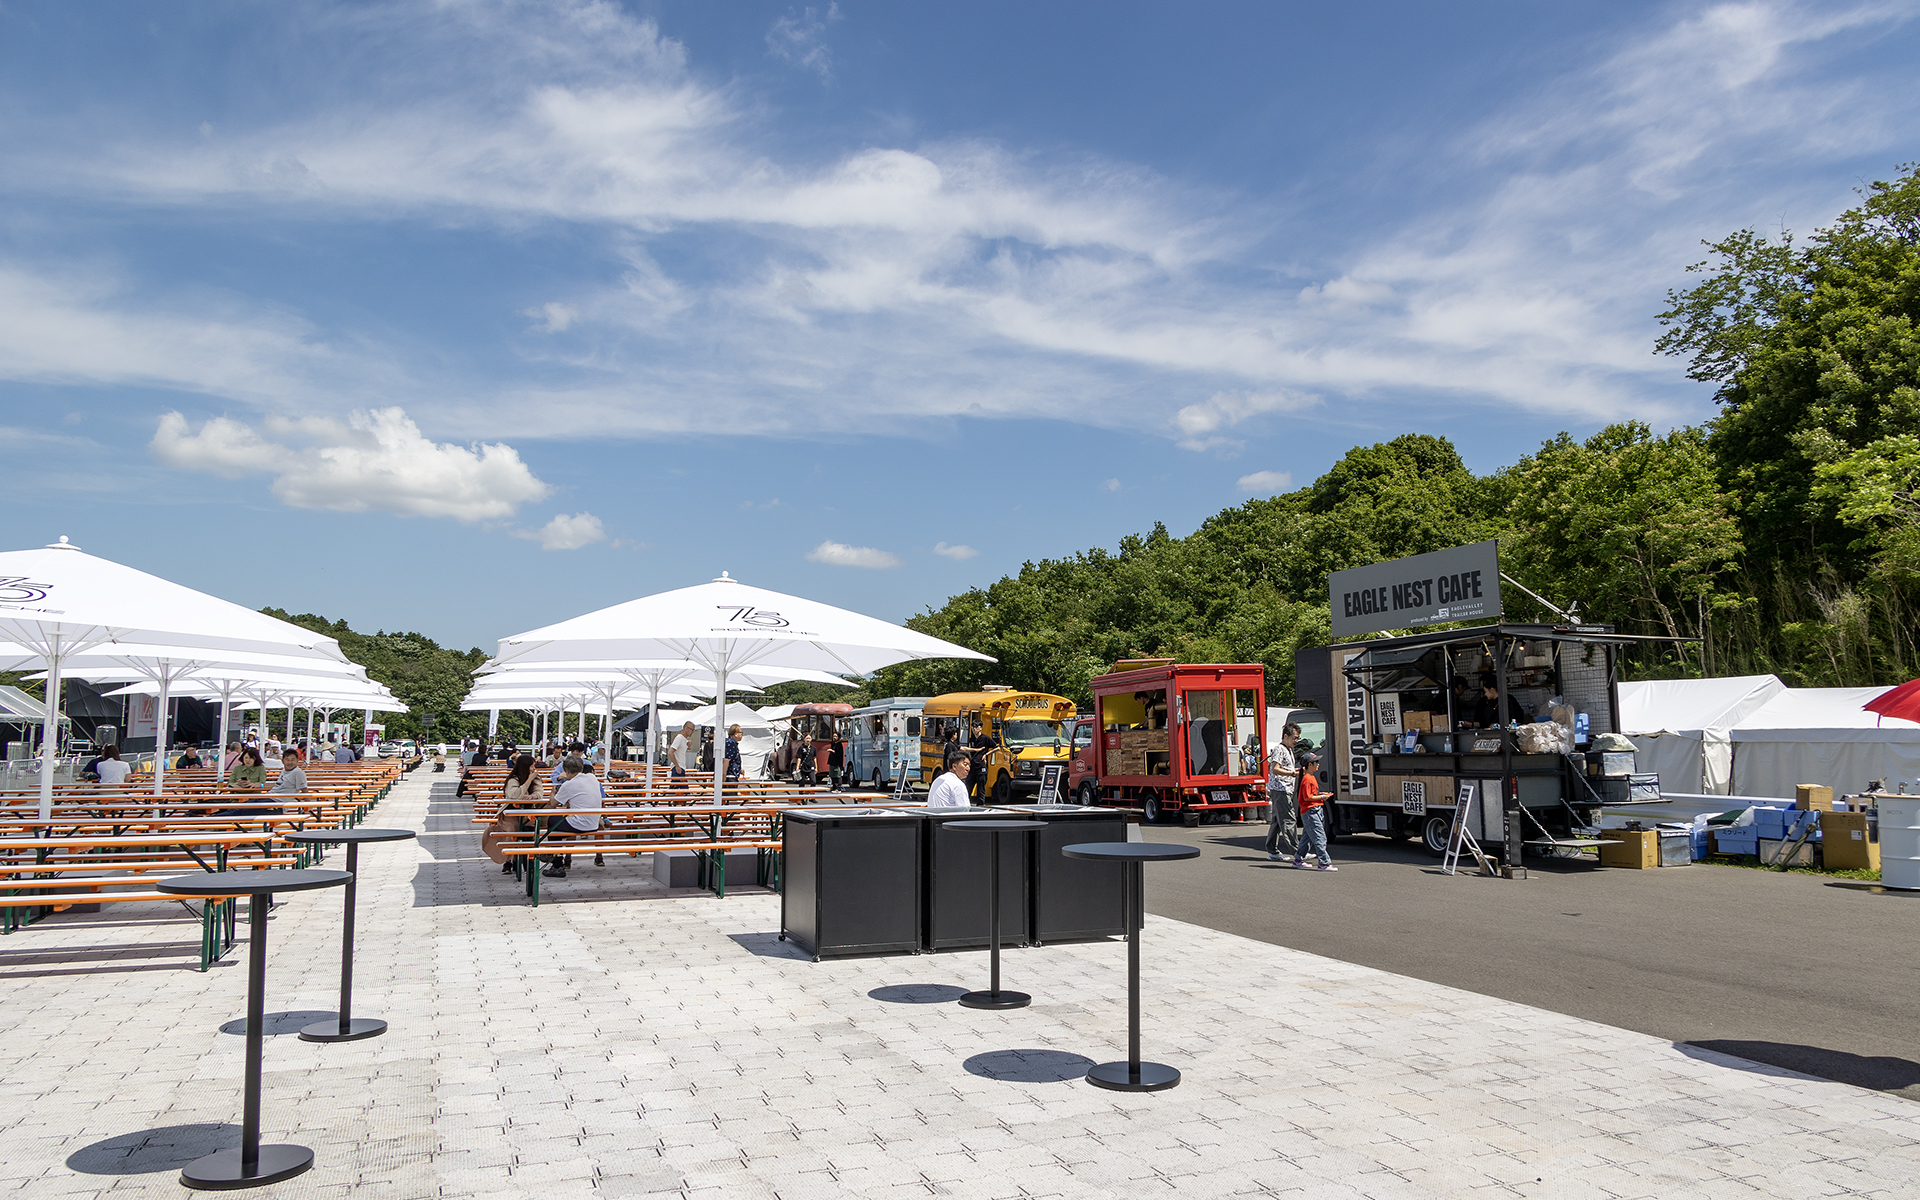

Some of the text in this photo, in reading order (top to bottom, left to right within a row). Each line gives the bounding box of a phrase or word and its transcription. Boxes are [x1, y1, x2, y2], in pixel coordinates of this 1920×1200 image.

[1344, 570, 1483, 618] EAGLE NEST CAFE
[1451, 602, 1483, 612] EAGLEVALLEY
[716, 605, 790, 628] 75
[1015, 698, 1049, 709] SCHOOL BUS
[1380, 701, 1395, 710] EAGLE
[1381, 709, 1396, 718] NEST
[1381, 717, 1397, 725] CAFE
[1403, 782, 1422, 793] EAGLE
[1404, 792, 1423, 802] NEST
[1404, 801, 1423, 812] CAFE
